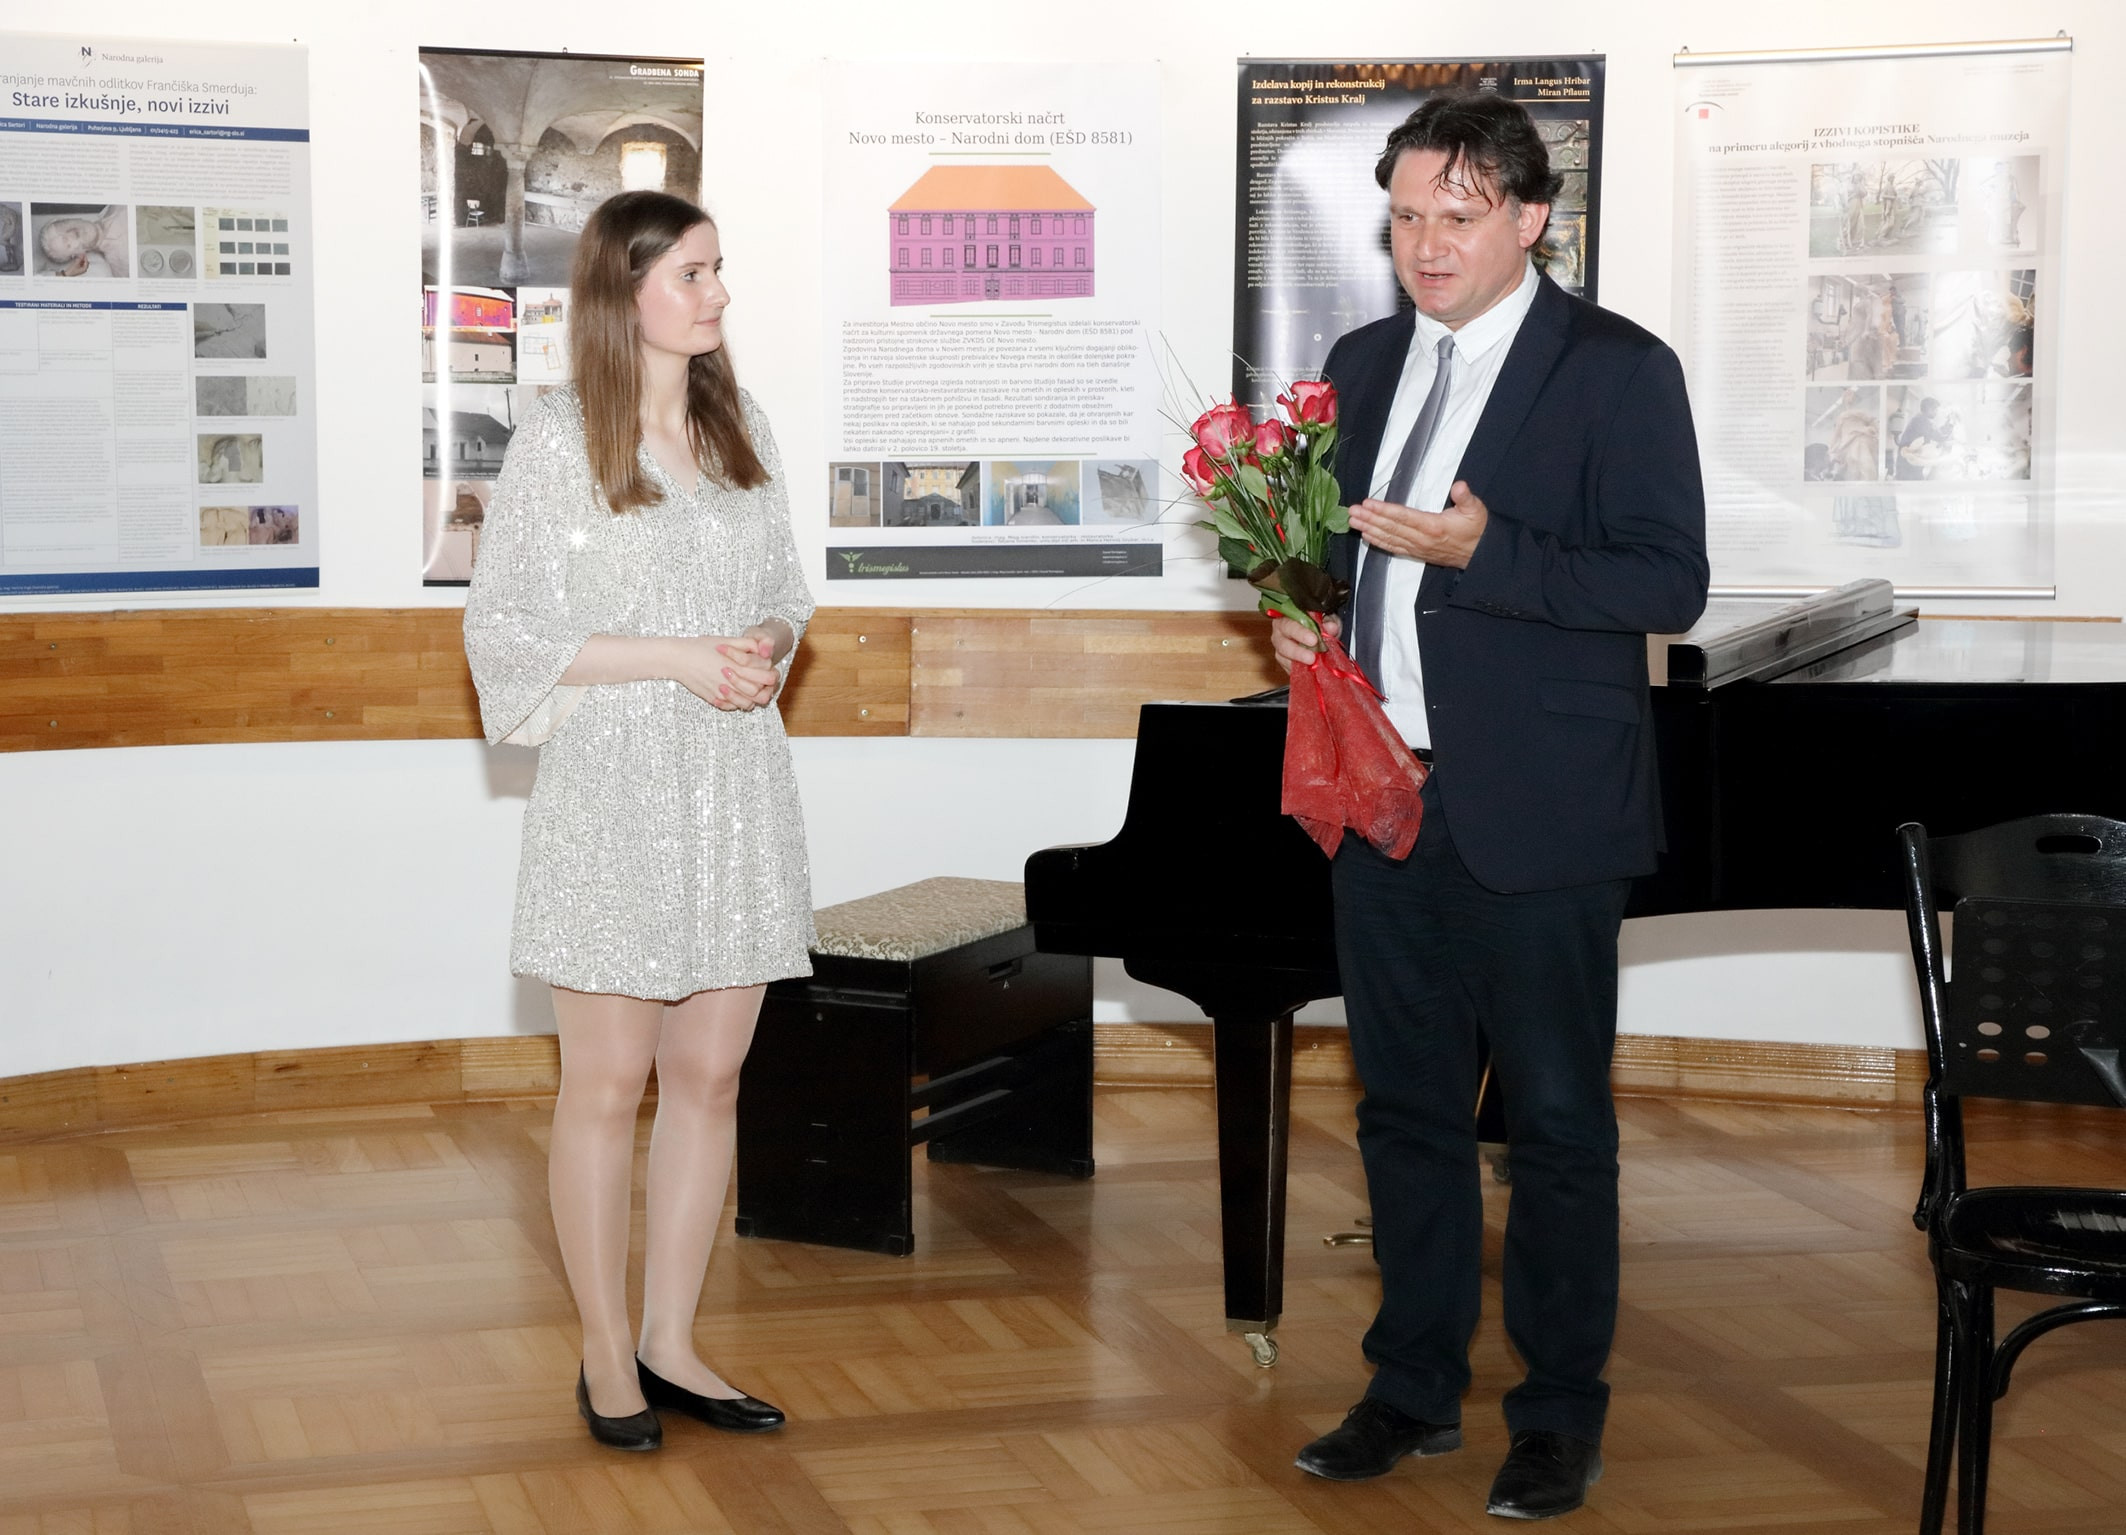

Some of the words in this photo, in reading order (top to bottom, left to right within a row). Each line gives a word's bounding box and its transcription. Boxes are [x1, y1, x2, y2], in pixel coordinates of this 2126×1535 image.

[102, 54, 134, 62] Narodna
[136, 56, 164, 65] galerija
[48, 76, 96, 88] mavčnih
[98, 77, 144, 90] odlitkov
[148, 80, 199, 92] Frančiška
[202, 82, 257, 97] Smerduja:
[1252, 80, 1289, 89] Izdelava
[1290, 80, 1313, 91] kopij
[1315, 80, 1324, 89] in
[1326, 79, 1385, 90] rekonstrukcij
[1514, 78, 1533, 86] Irma
[1535, 77, 1562, 87] Langus
[1564, 76, 1590, 84] Hribar
[1563, 88, 1590, 96] Pflaum
[12, 92, 59, 108] Stare
[65, 92, 141, 114] izkušnje,
[148, 98, 182, 112] novi
[188, 98, 229, 114] izzivi
[1264, 96, 1303, 104] razstavo
[1305, 94, 1340, 104] Kristus
[1342, 94, 1366, 106] Kralj
[915, 112, 1023, 124] Konservatorski
[1028, 111, 1065, 124] načrt
[1814, 127, 1852, 137] IZZIVI
[1854, 124, 1920, 135] KOPISTIKE
[849, 131, 886, 144] Novo
[892, 132, 935, 144] mesto
[952, 131, 1010, 144] Narodni
[1014, 131, 1044, 144] dom
[1050, 130, 1086, 146] (EŠD
[1091, 131, 1132, 145] 8581)
[1723, 142, 1767, 155] primeru
[1770, 140, 1809, 152] alegorij
[1819, 138, 1871, 149] vhodnega
[1873, 136, 1924, 148] stopnišča
[1990, 131, 2029, 142] muzeja
